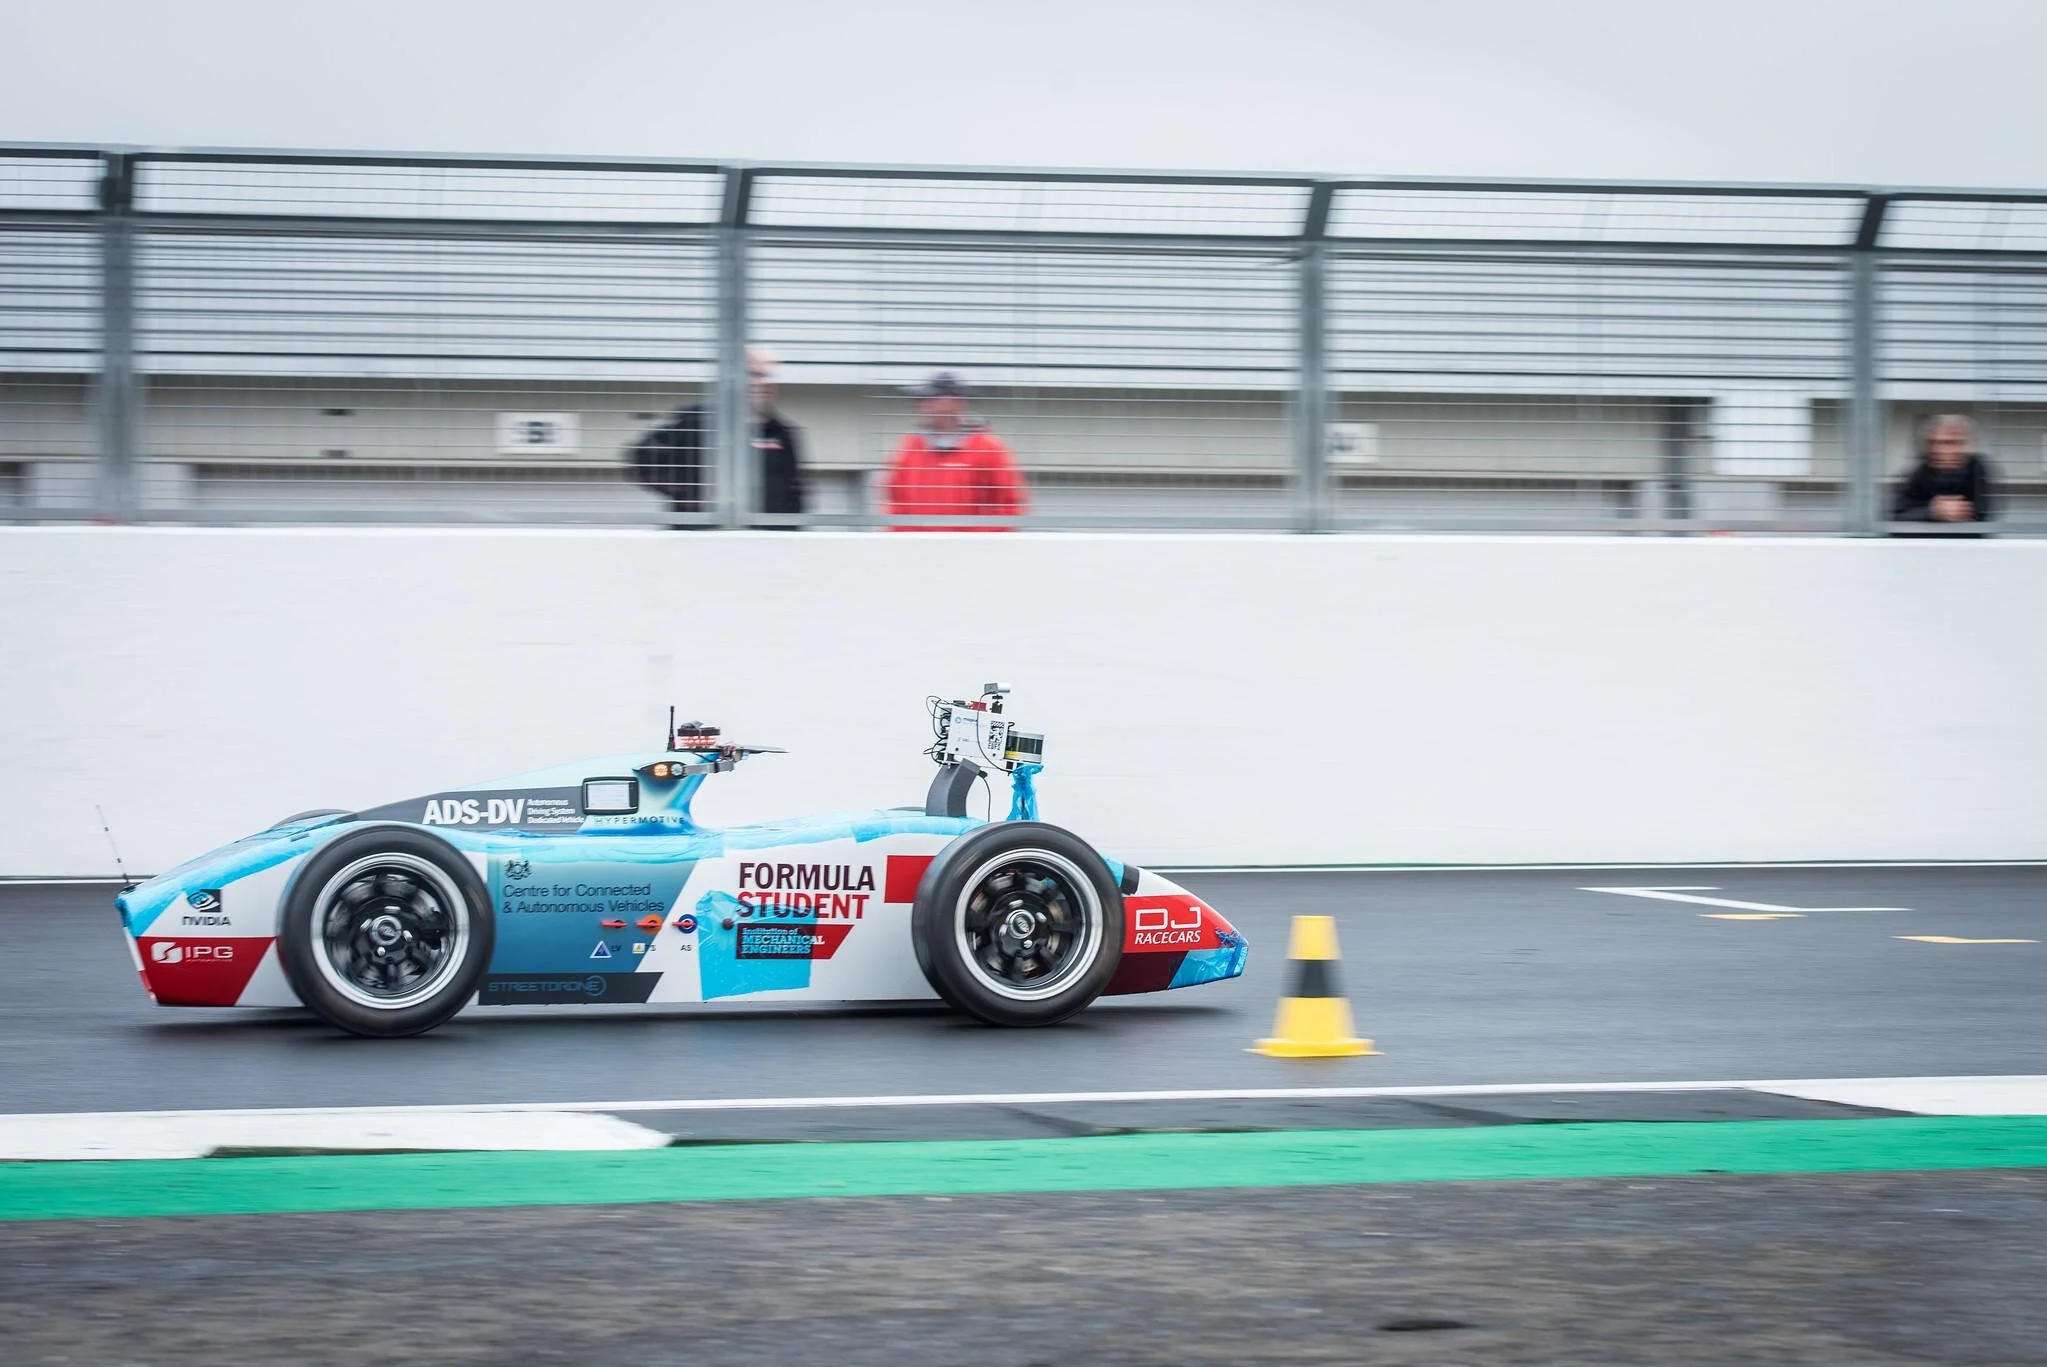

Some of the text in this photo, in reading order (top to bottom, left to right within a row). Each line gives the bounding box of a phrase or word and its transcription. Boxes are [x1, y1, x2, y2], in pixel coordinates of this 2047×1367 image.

[422, 799, 525, 825] ADS-DV
[595, 816, 685, 825] HYPERMOTIVE
[739, 862, 876, 891] FORMULA
[502, 883, 652, 898] Centre for Connected
[503, 899, 665, 913] & Autonomous Vehicles
[737, 891, 870, 920] STUDENT
[182, 916, 232, 926] NVIDIA
[1135, 906, 1202, 931] DJ
[788, 928, 799, 936] of
[1135, 930, 1202, 945] RACECARS
[742, 935, 826, 945] MECHANICAL
[185, 946, 234, 959] IPG
[680, 944, 692, 952] AS
[741, 944, 812, 954] ENGINEERS
[488, 979, 603, 994] STREETDRONE
